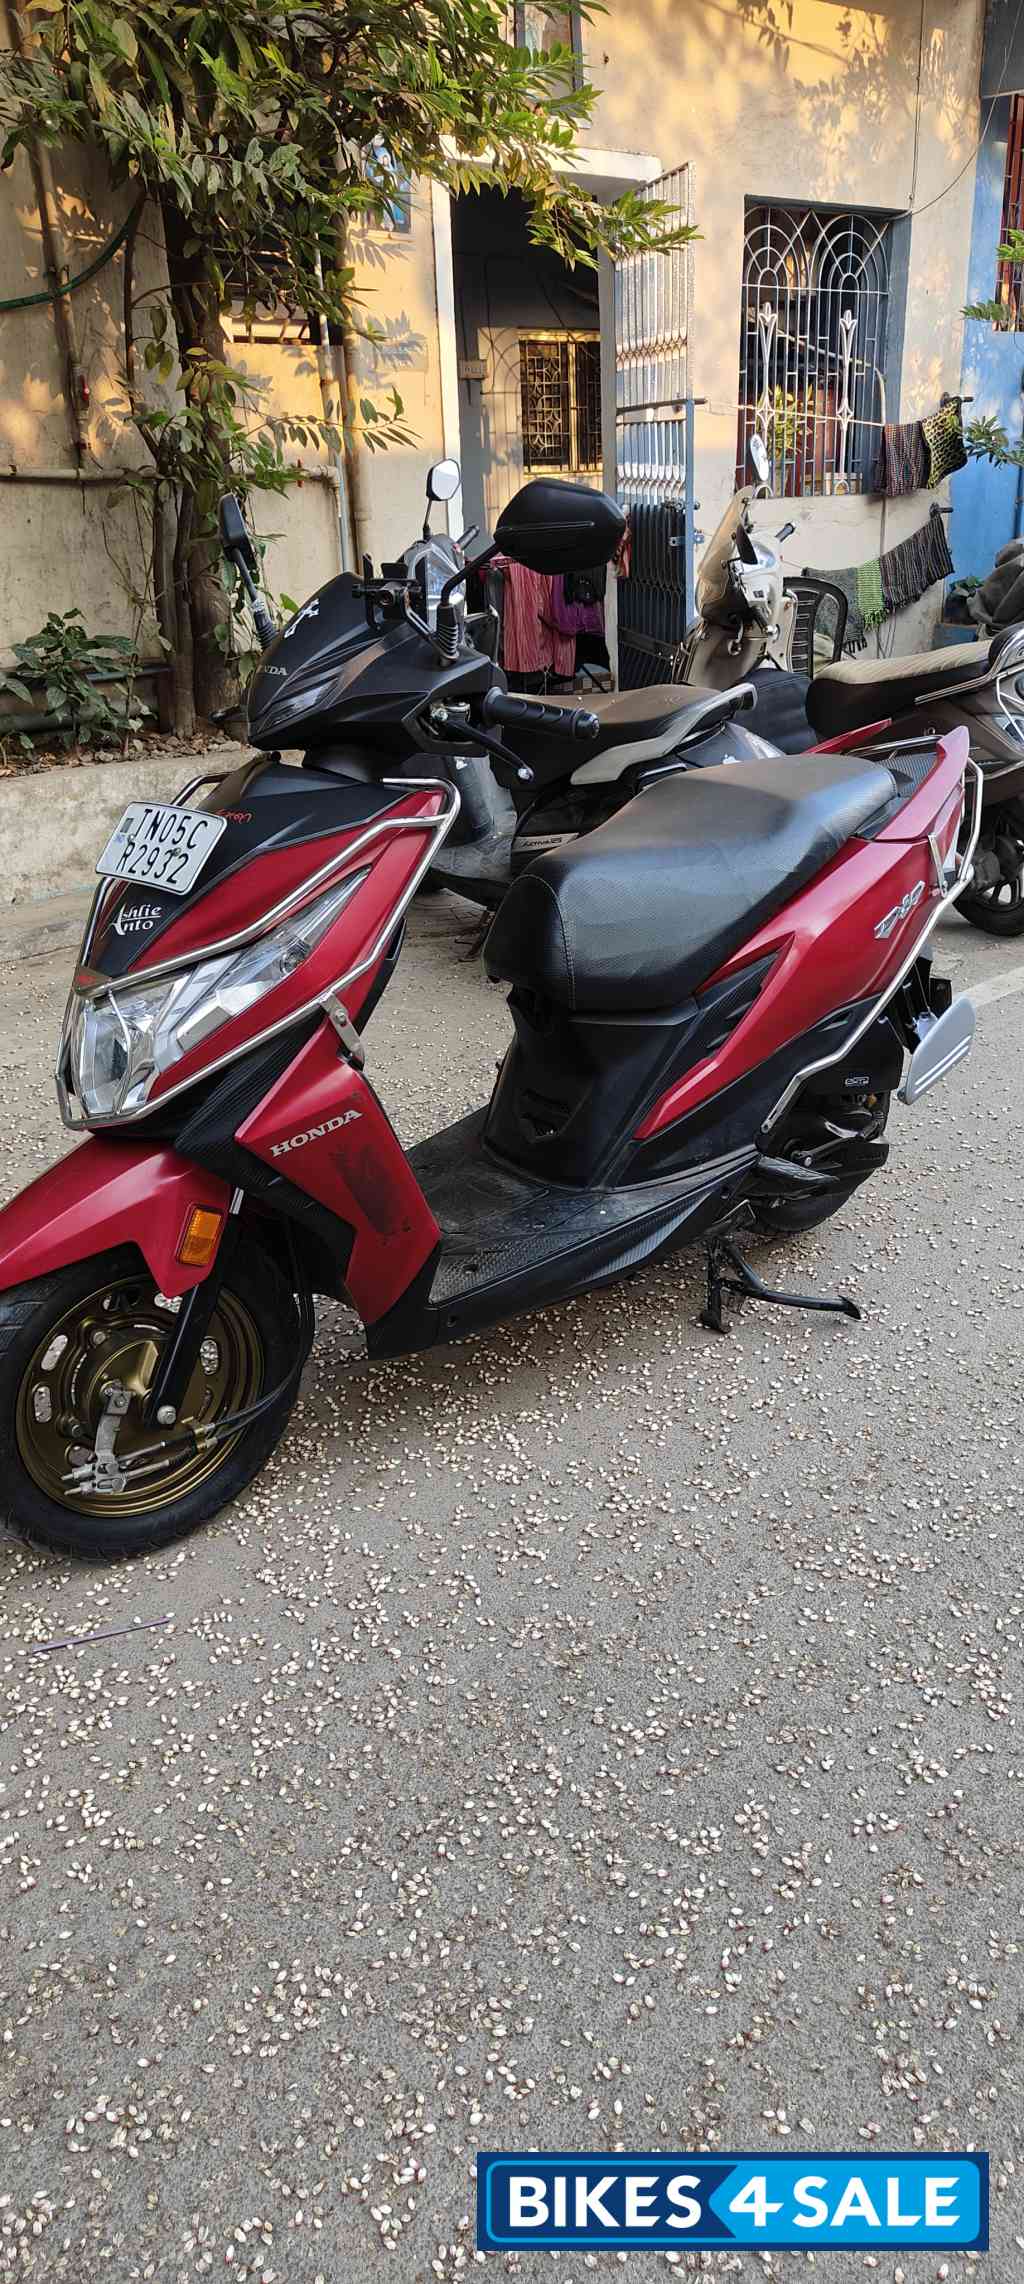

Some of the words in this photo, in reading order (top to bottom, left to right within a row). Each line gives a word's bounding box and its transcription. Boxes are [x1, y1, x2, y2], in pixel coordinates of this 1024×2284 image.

[135, 808, 208, 850] TN05C
[116, 842, 189, 884] R2932
[269, 1109, 363, 1157] HONDA
